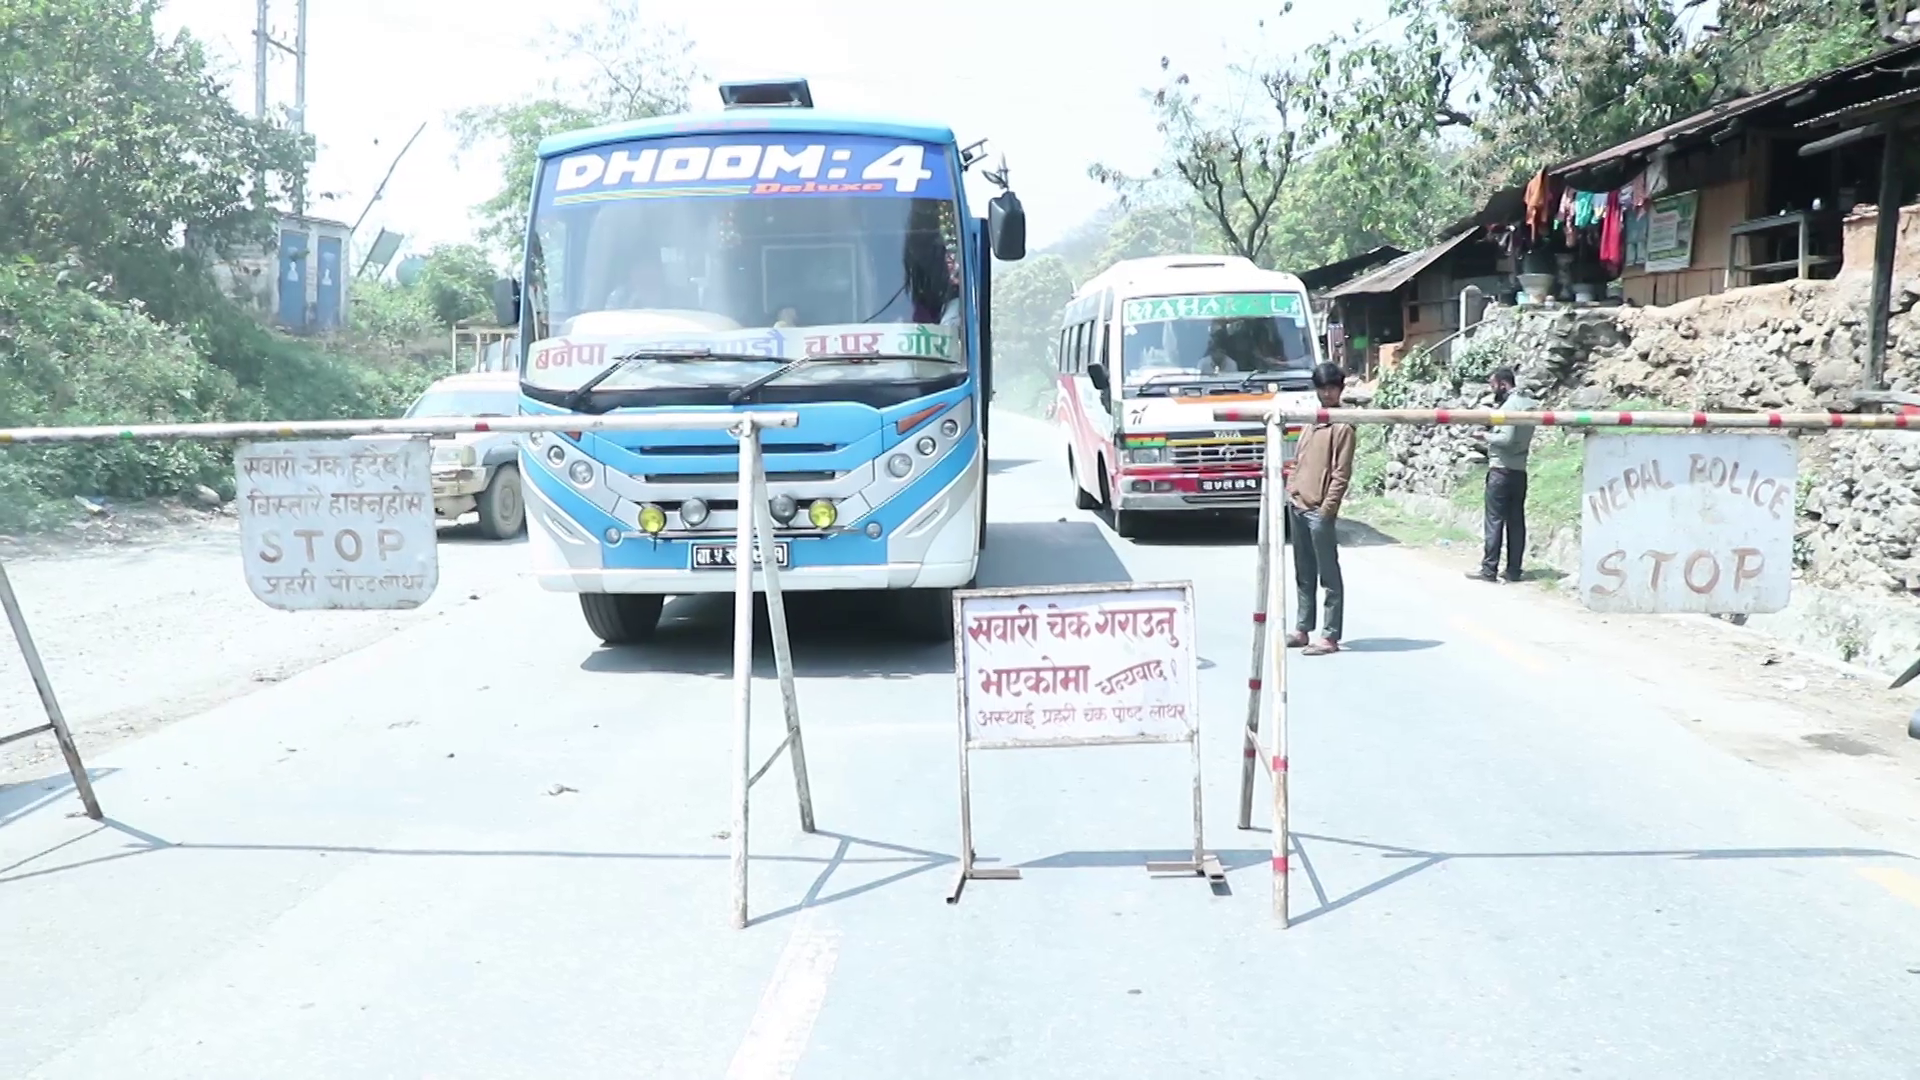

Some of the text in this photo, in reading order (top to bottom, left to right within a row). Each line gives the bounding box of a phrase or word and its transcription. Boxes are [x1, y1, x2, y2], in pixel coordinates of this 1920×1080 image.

[751, 181, 884, 196] Deluxe
[898, 324, 954, 358] गौर
[1588, 452, 1791, 525] NEPAL POLICE
[259, 528, 405, 564] STOP
[1590, 547, 1766, 596] STOP
[967, 602, 1180, 651] सवारी चेक गराउनु
[978, 655, 1091, 698] भएकोमा
